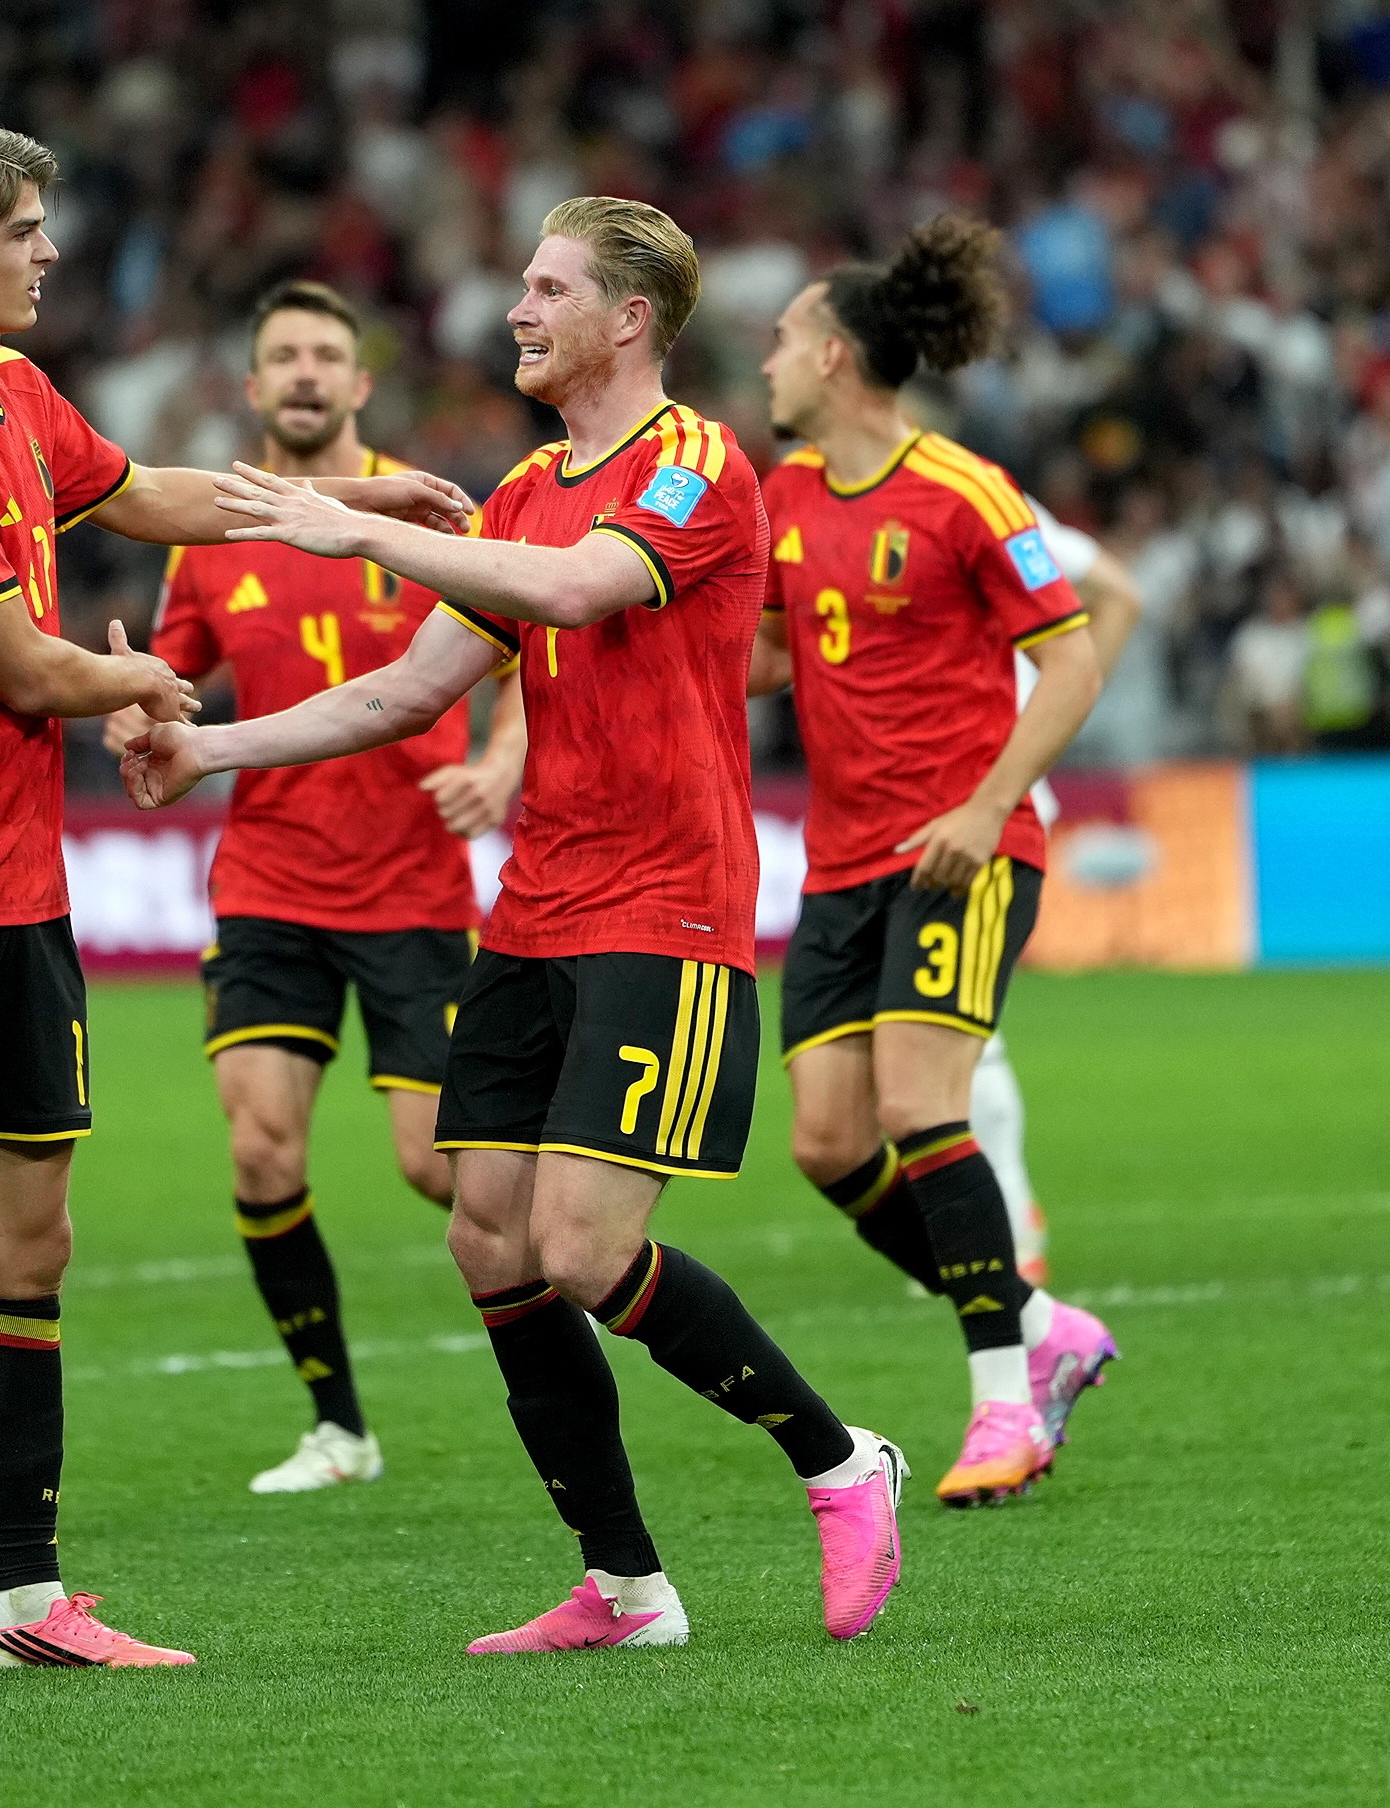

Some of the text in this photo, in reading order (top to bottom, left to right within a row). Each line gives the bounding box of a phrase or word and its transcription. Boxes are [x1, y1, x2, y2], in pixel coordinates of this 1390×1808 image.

[653, 489, 680, 510] PEACE
[300, 613, 344, 687] 4
[816, 588, 850, 664] 3
[914, 921, 959, 998] 3
[619, 1045, 660, 1135] 7
